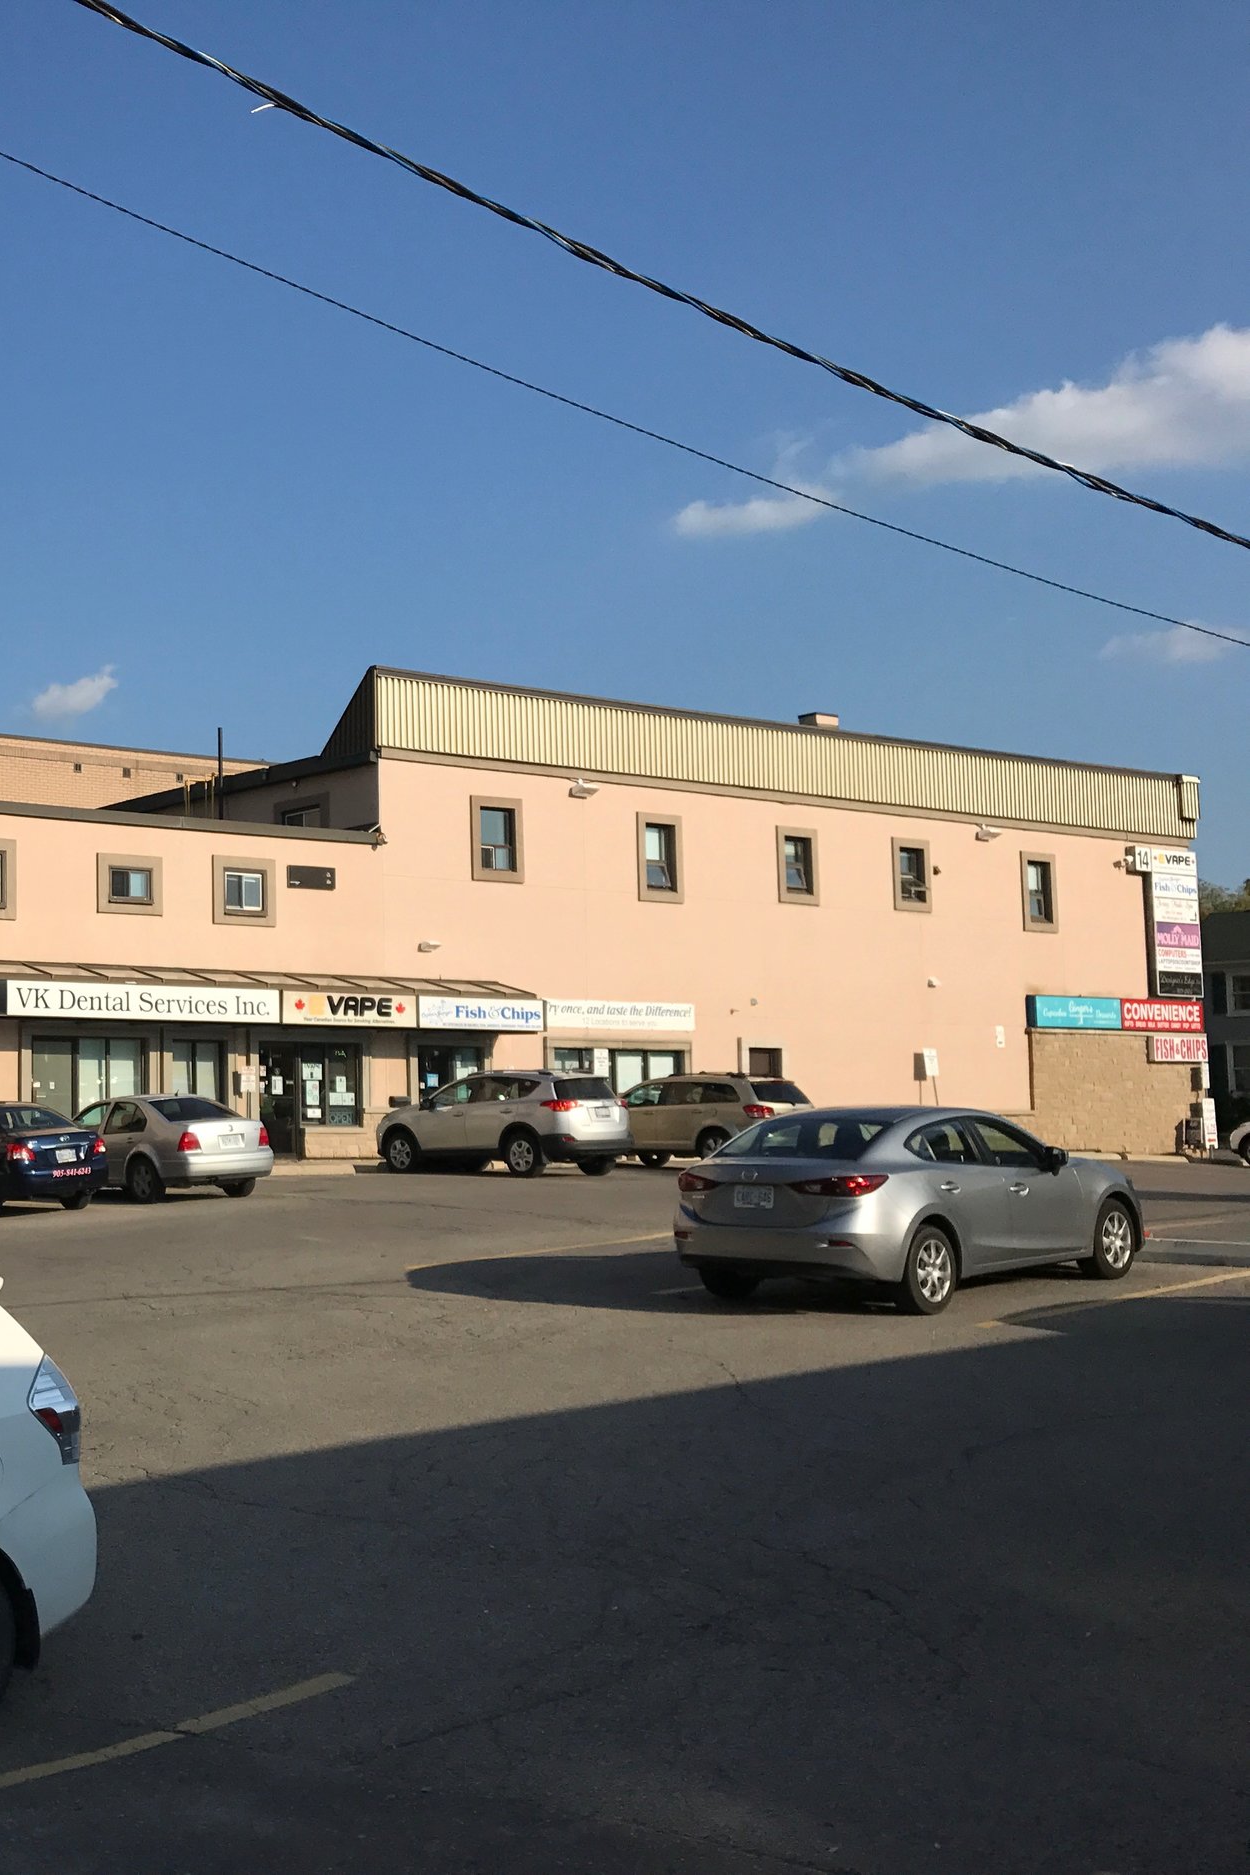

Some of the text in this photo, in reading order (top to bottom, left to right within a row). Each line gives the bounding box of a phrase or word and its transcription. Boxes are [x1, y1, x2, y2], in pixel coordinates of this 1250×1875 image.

[1137, 850, 1149, 869] 14
[1165, 854, 1191, 866] VAPE
[1157, 932, 1199, 947] MOLLY MAID
[16, 987, 270, 1016] VK Dental Services Inc.
[326, 995, 393, 1017] VAPE
[586, 1004, 606, 1015] and
[629, 1005, 642, 1016] the
[455, 1005, 487, 1019] Fish
[501, 1007, 541, 1023] Chips
[1123, 1002, 1201, 1022] CONVENIENCE
[1155, 1038, 1175, 1059] FISH
[1180, 1038, 1207, 1060] CHIPS
